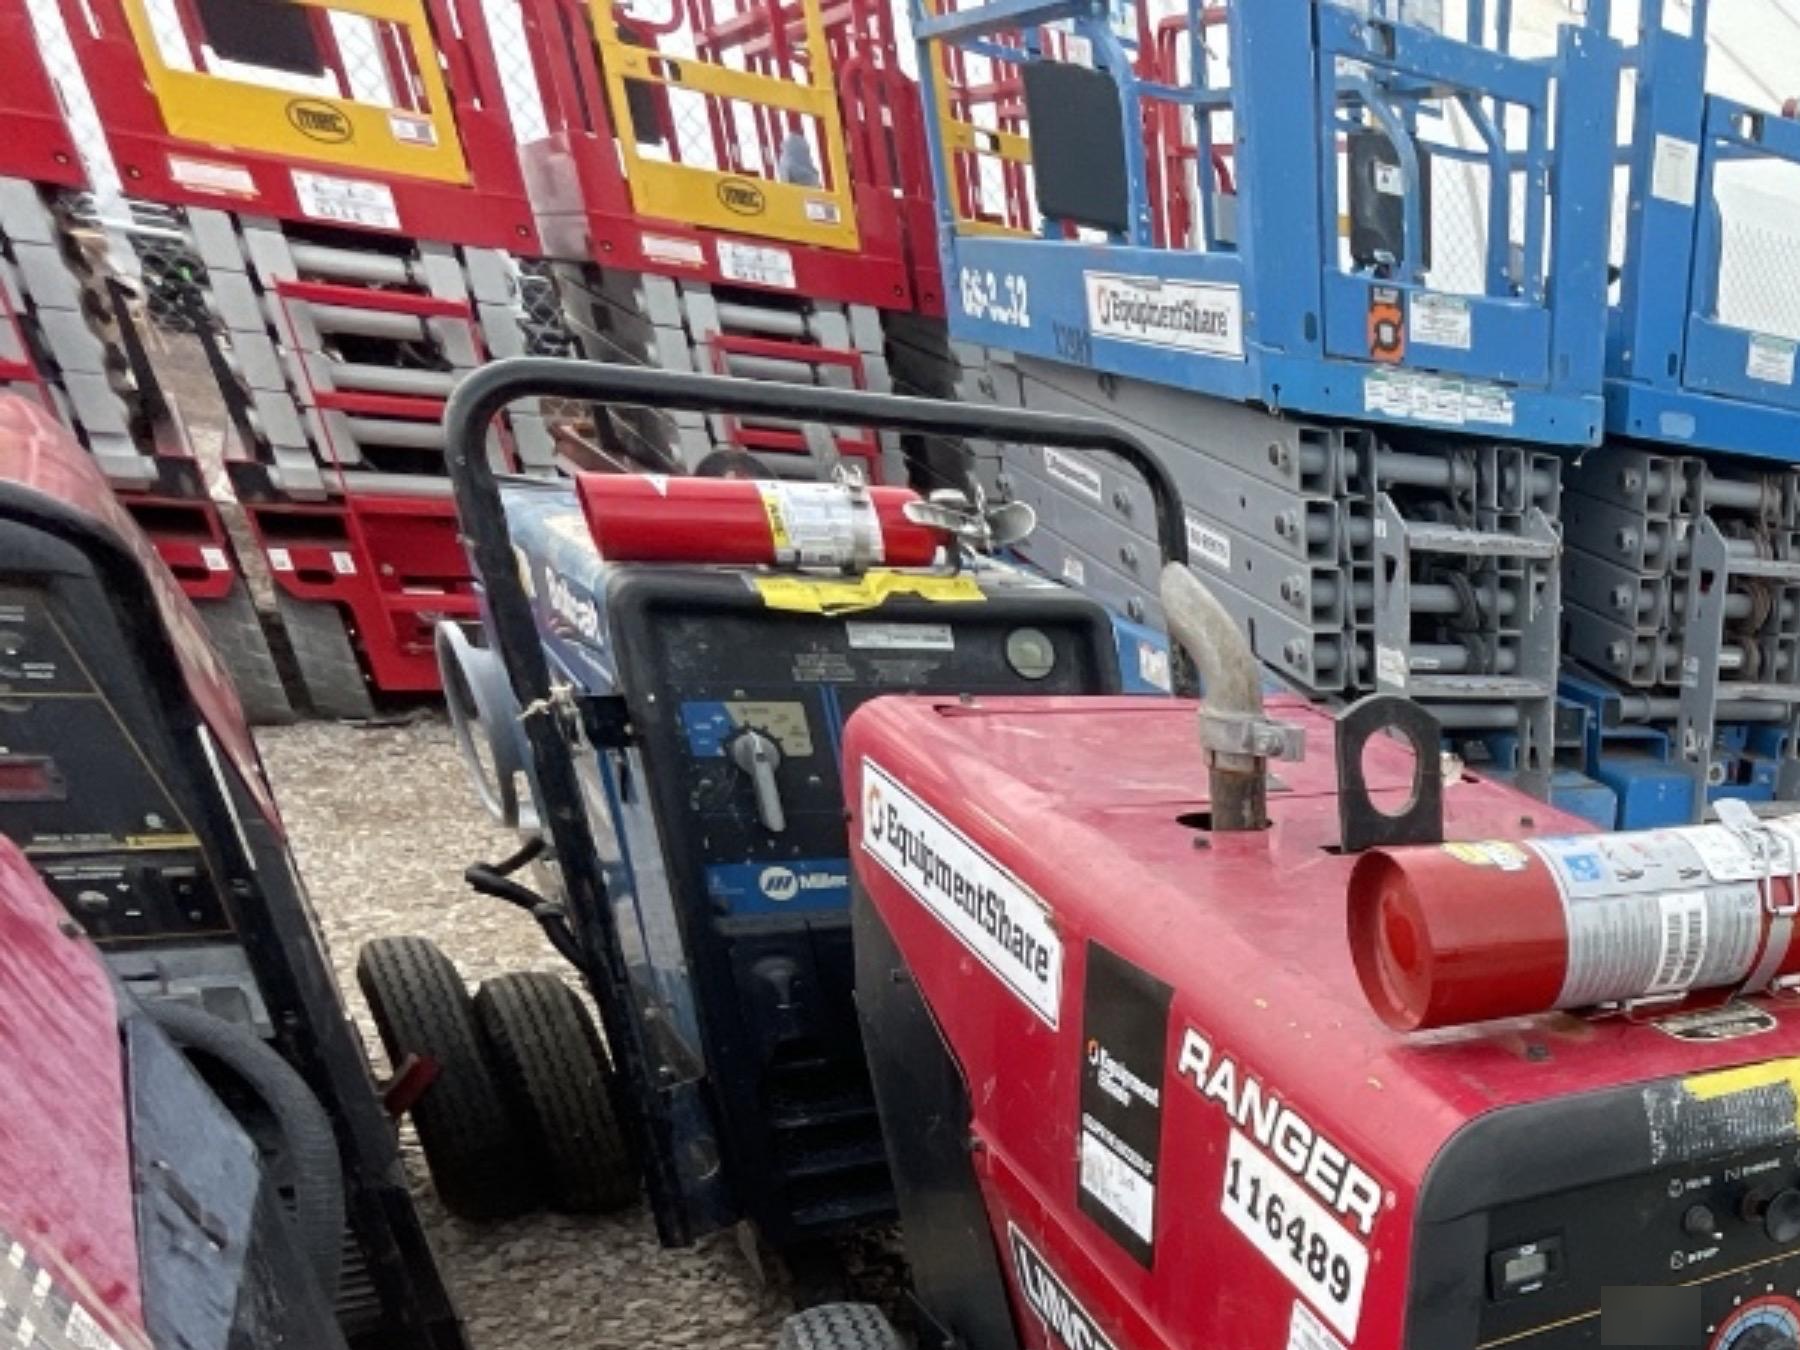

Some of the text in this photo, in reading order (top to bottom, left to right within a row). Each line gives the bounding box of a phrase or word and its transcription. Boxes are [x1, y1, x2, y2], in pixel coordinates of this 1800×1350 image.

[886, 804, 1052, 984] EquipmentShare
[1177, 1026, 1384, 1234] RANGER
[1226, 1159, 1353, 1304] 116489
